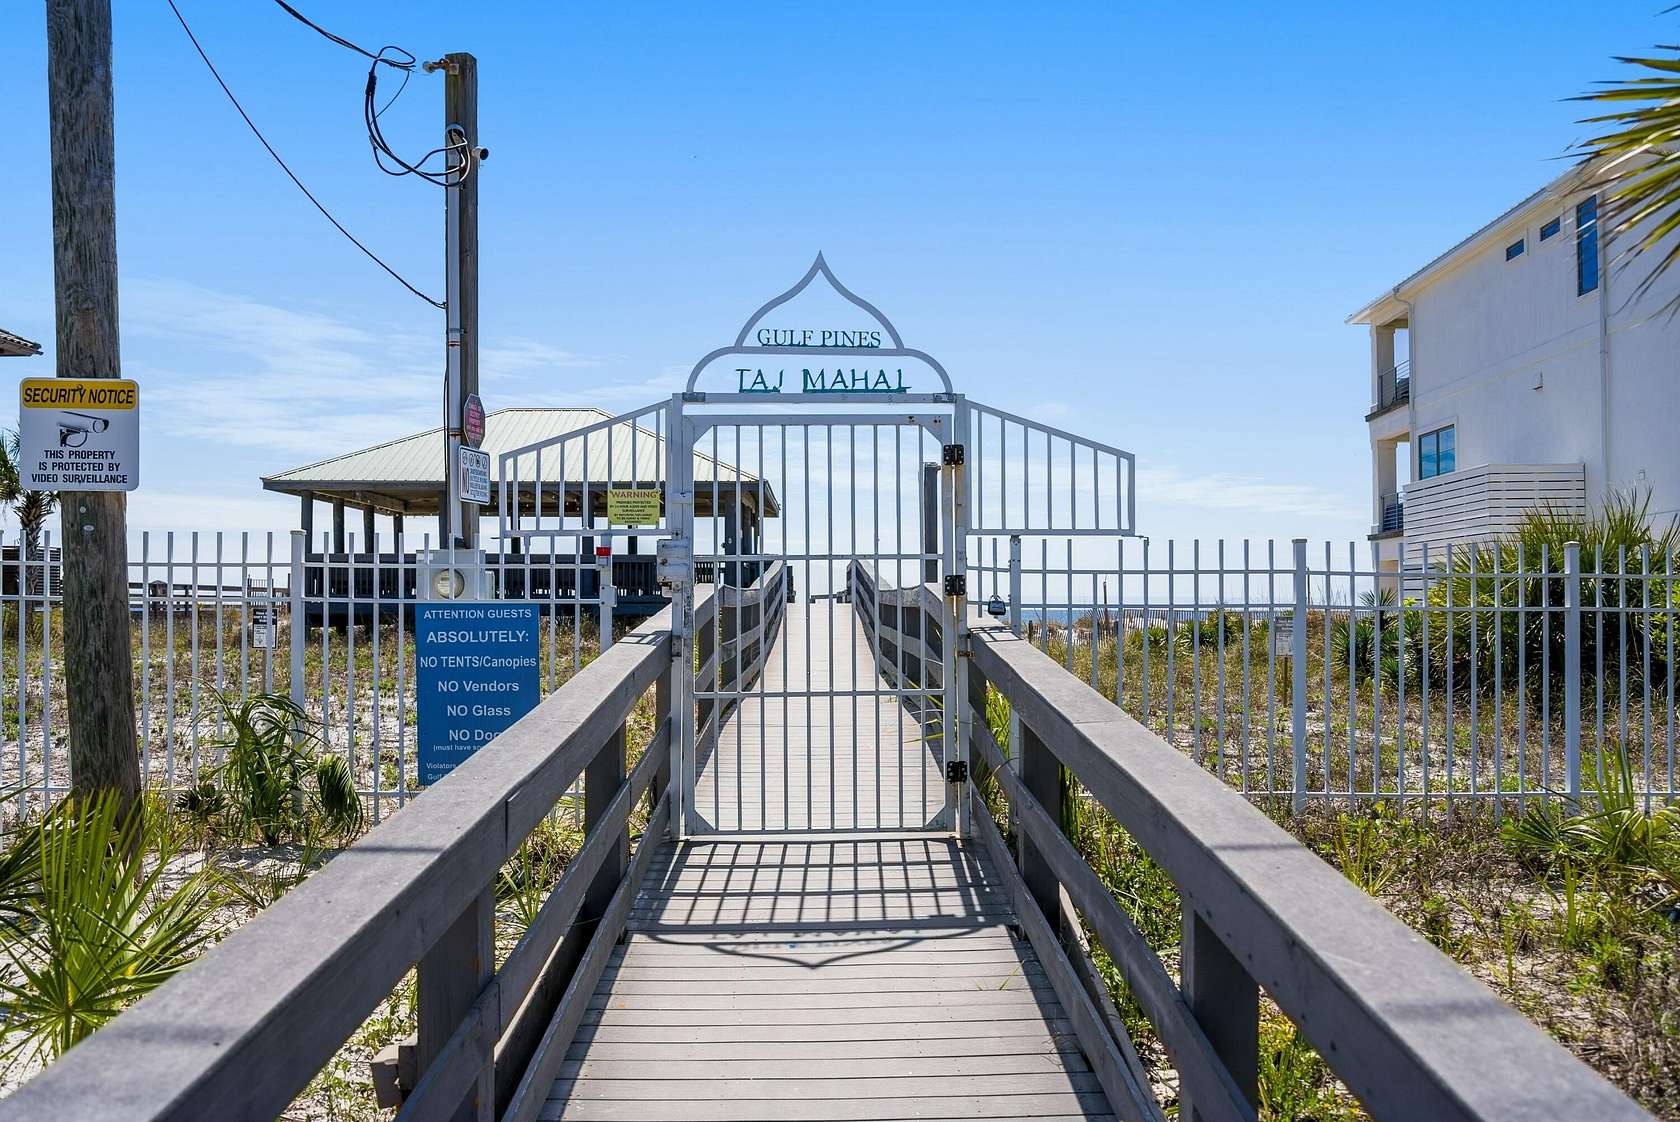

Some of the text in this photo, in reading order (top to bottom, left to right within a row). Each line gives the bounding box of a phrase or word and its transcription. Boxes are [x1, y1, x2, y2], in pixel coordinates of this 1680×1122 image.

[757, 328, 881, 348] GULF PINES
[735, 368, 912, 393] TAJ MAHAL
[24, 388, 135, 404] SECURITY NOTICE
[44, 450, 115, 460] THIS PROPERTY
[39, 462, 120, 472] IS PROTECTED BY
[32, 474, 128, 484] VIDEO SURVEILLANCE
[424, 608, 532, 619] ATTENTION GUESTS
[426, 630, 529, 643] ABSOLUTELY:
[420, 655, 537, 669] NO TENTS/Canopies
[438, 680, 520, 692] NO Vendors
[447, 704, 511, 717] NO Glass
[449, 729, 470, 741] NO
[433, 744, 453, 752] (must
